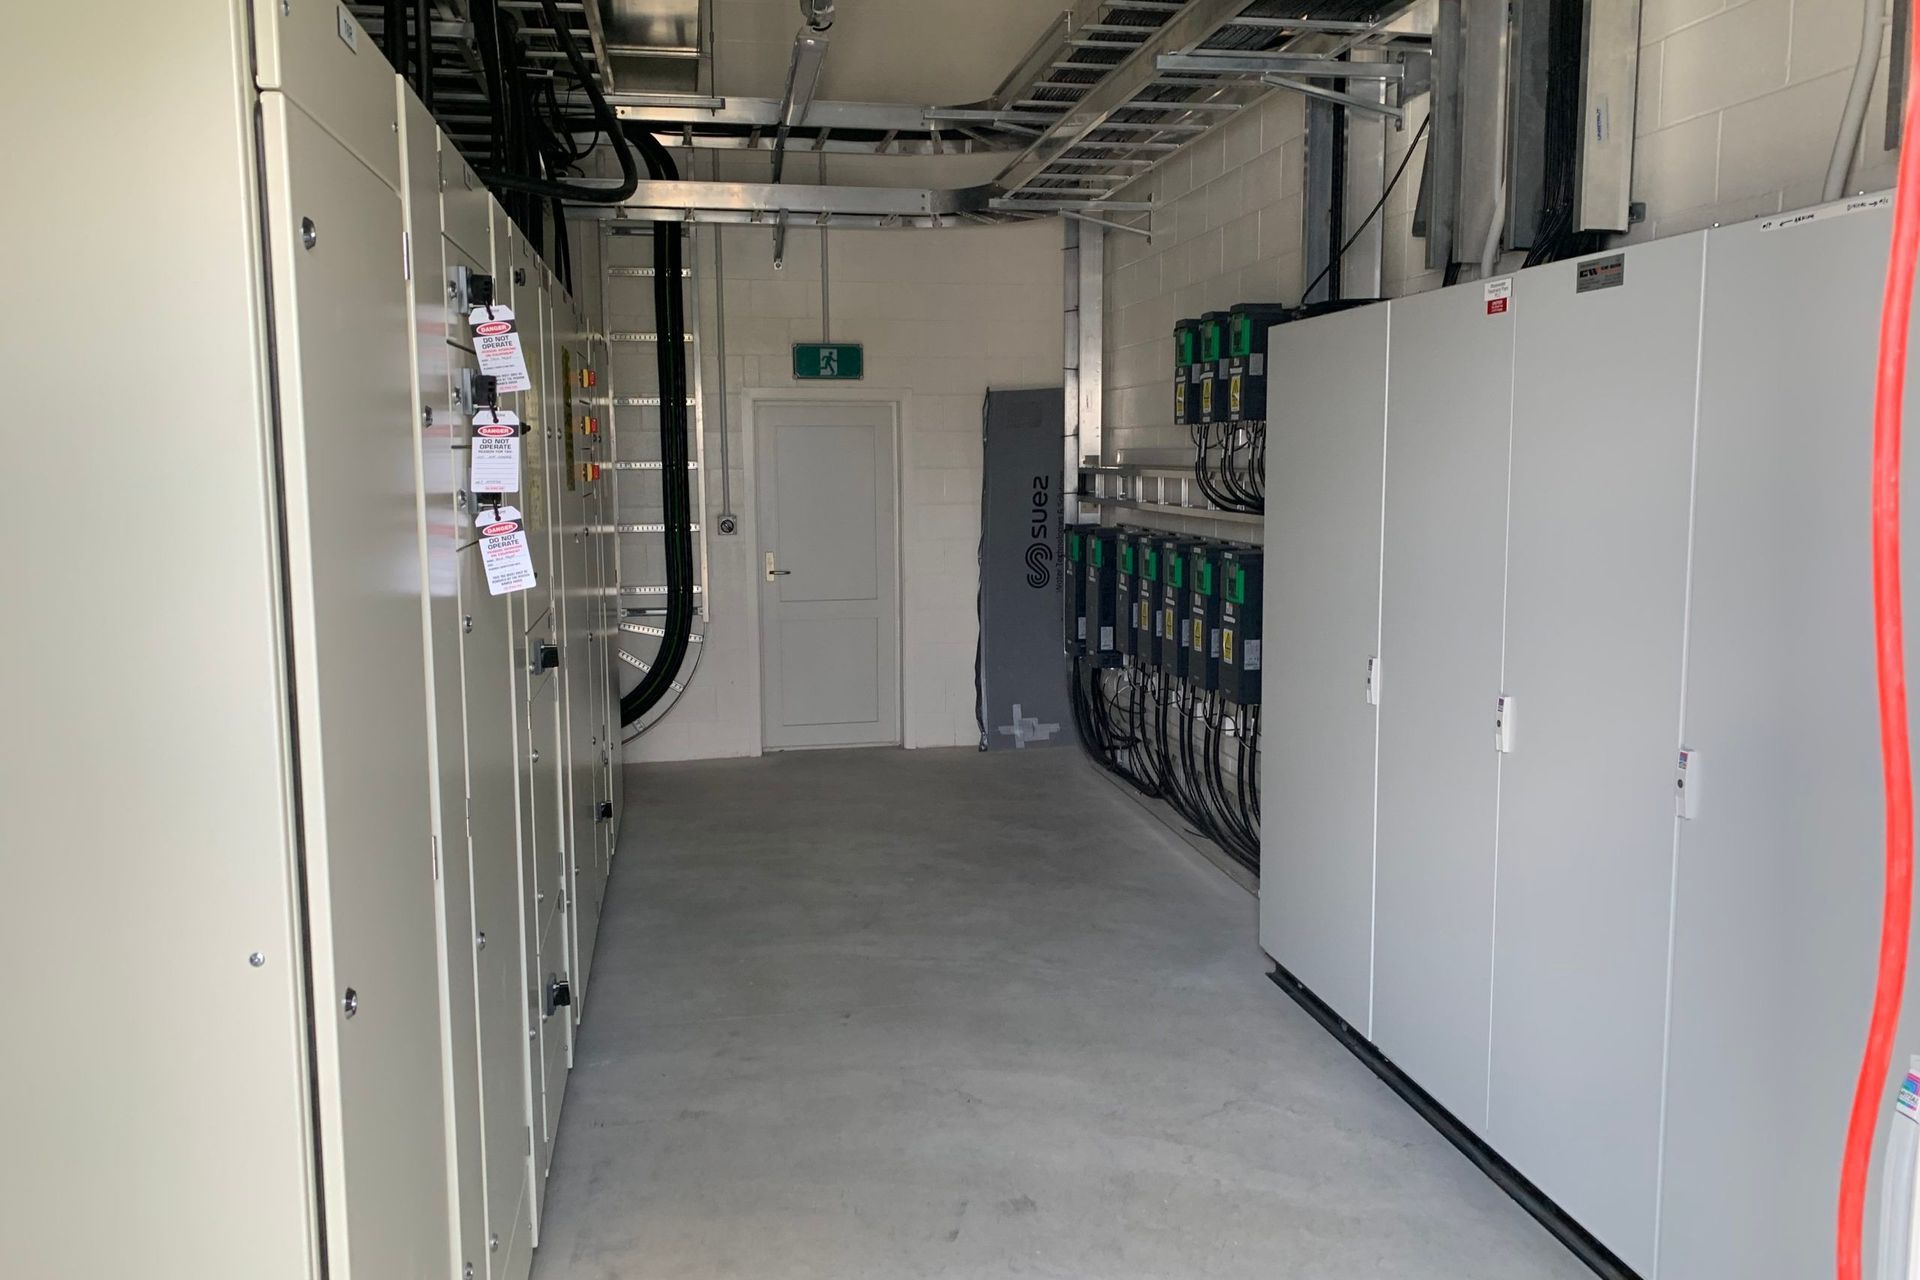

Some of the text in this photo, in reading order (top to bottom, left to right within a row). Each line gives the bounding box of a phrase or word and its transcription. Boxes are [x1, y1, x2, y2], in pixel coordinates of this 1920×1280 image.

[481, 324, 507, 333] DANGER
[481, 341, 513, 350] OPERATE
[1031, 475, 1049, 539] suez
[488, 524, 514, 534] DANGER
[487, 539, 519, 550] OPERATE
